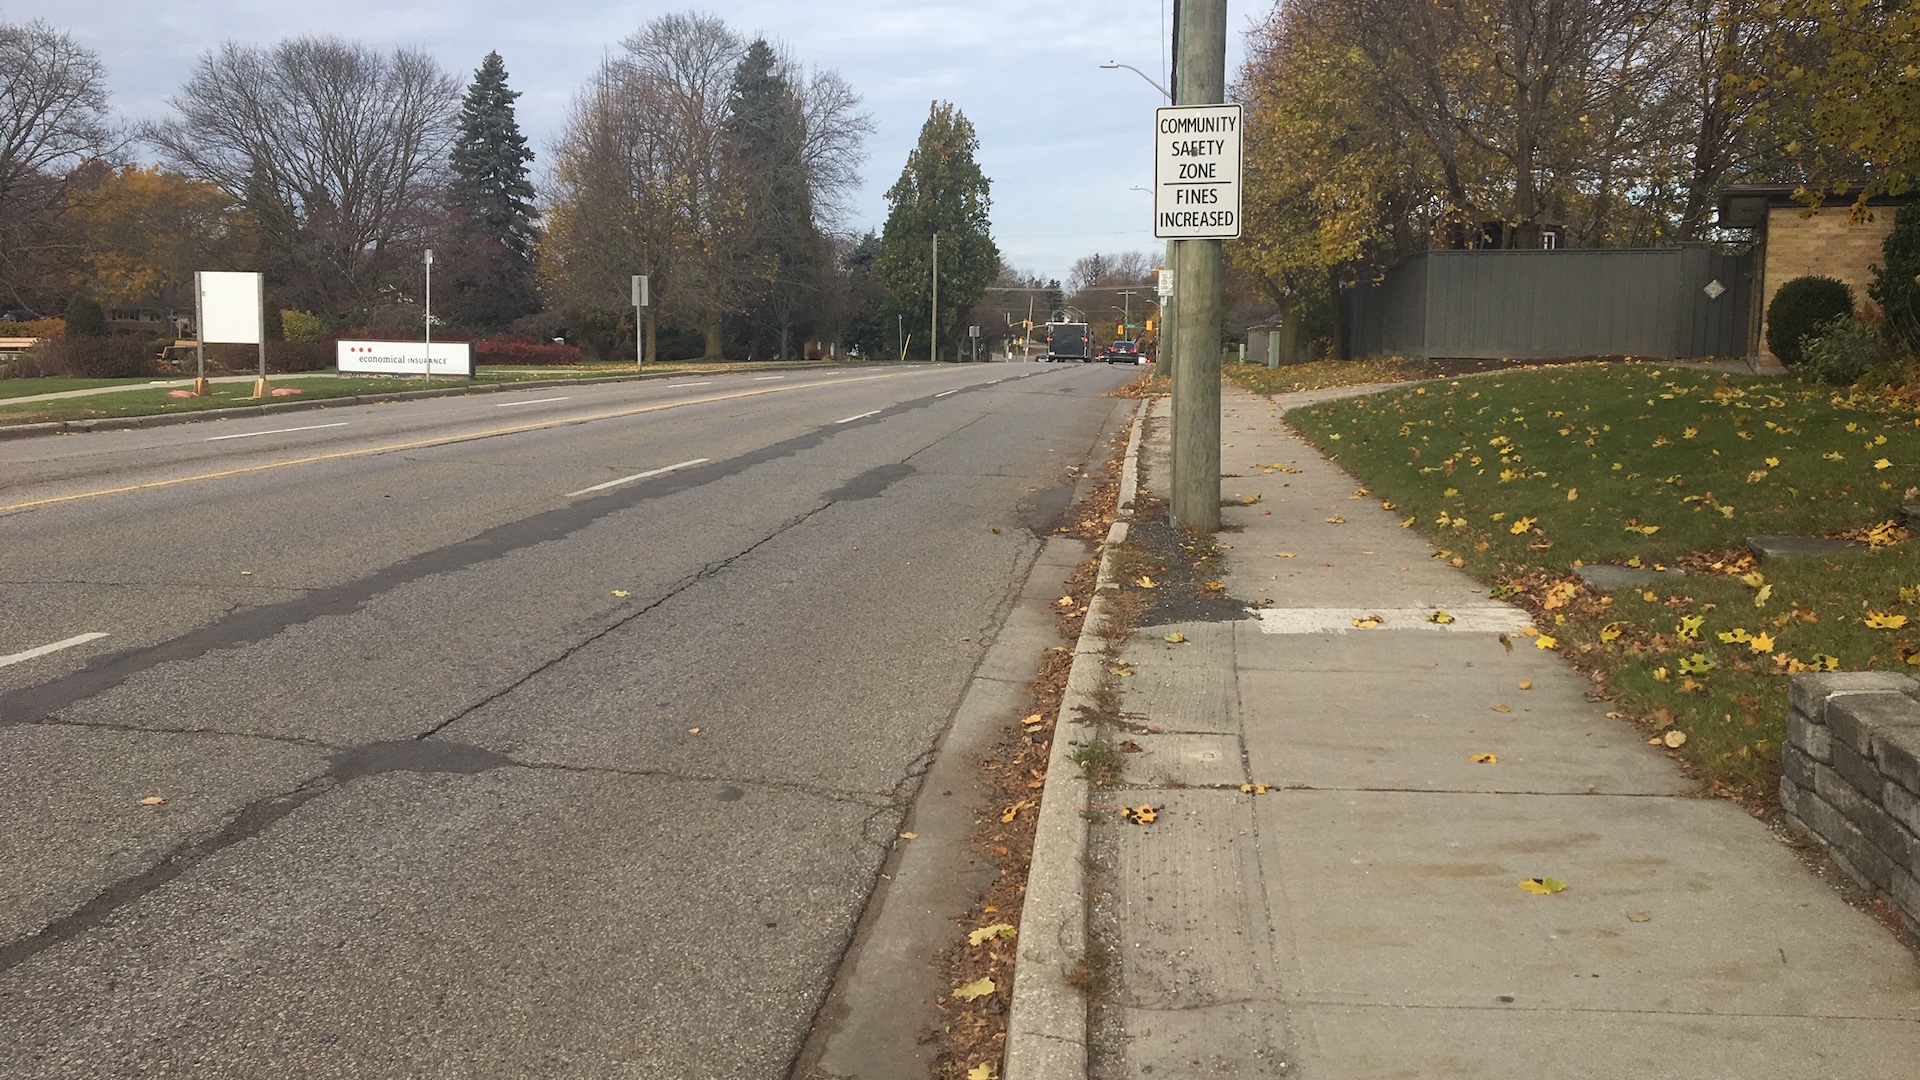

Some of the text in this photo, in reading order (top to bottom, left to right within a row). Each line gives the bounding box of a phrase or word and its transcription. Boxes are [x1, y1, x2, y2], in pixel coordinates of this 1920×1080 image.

[1160, 116, 1236, 134] COMMUNITY
[1171, 140, 1224, 156] SAFETY
[1179, 163, 1216, 179] ZONE
[1176, 188, 1218, 204] FINES
[1160, 211, 1234, 227] INCREASED
[359, 355, 405, 363] economical
